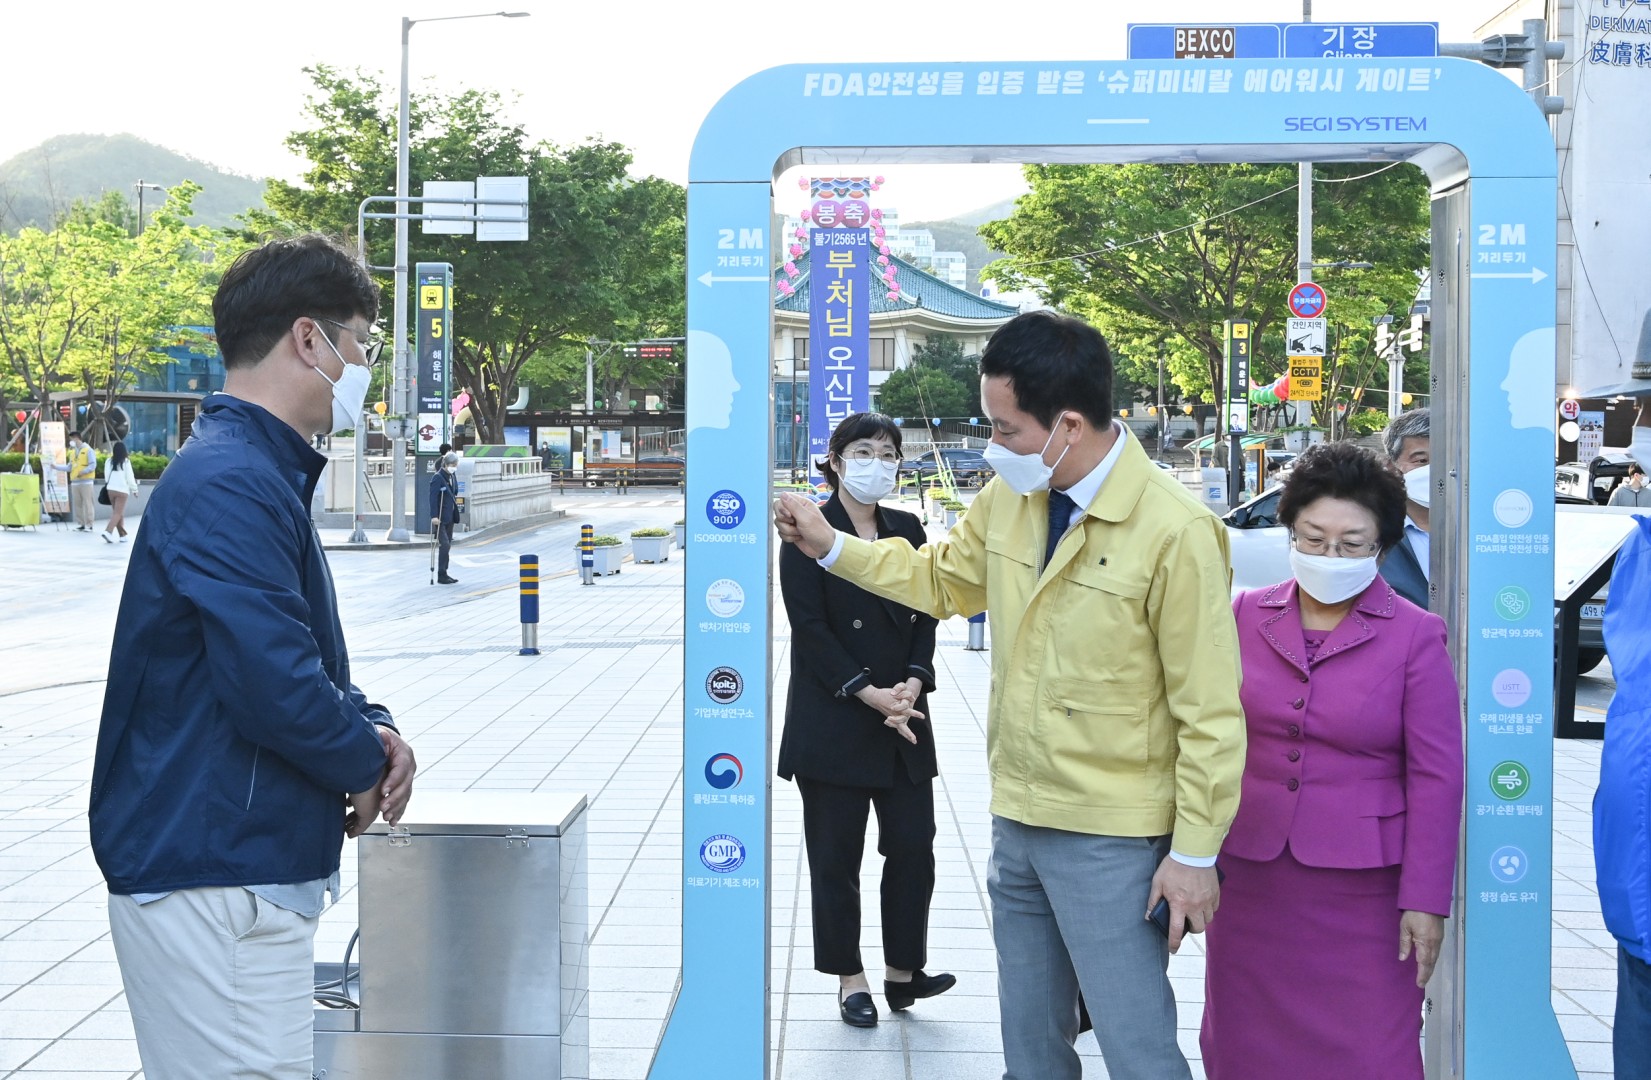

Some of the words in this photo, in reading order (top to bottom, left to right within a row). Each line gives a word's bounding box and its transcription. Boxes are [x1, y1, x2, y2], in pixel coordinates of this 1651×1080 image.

[1176, 29, 1233, 52] BEXCO
[1322, 26, 1377, 50] 기장
[804, 70, 964, 97] FDA안전성을
[976, 71, 1024, 95] 입증
[1036, 70, 1085, 95] 받은
[1243, 68, 1344, 93] 에어워시
[1284, 117, 1333, 131] SEGI
[1336, 117, 1427, 131] SYSTEM
[816, 203, 865, 225] 봉축
[717, 228, 764, 249] 2M
[1478, 223, 1526, 245] 2M
[717, 256, 764, 267] 거리두기
[1477, 252, 1526, 263] 거리두기
[825, 250, 856, 337] 부처님
[431, 318, 442, 339] 5
[1239, 342, 1247, 354] 3
[433, 349, 442, 383] 해운대
[1293, 368, 1317, 376] CCTV
[1564, 402, 1577, 417] 약
[712, 499, 740, 510] ISO
[713, 516, 739, 524] 9001
[739, 533, 757, 544] 인증
[1509, 534, 1532, 544] 안전성
[1533, 534, 1550, 544] 인증
[1475, 545, 1508, 554] FDA피부
[1509, 545, 1532, 554] 안전성
[1533, 545, 1550, 554] 인증
[699, 621, 752, 633] 벤처기업인증
[1481, 628, 1508, 639] 항균력
[1508, 628, 1543, 638] 99.99%
[713, 679, 737, 690] koita
[1502, 683, 1520, 691] USTT
[694, 708, 755, 719] 기업부설연구소
[1479, 713, 1497, 724] 유해
[1498, 713, 1524, 724] 미생물
[1525, 713, 1543, 724] 살균
[1488, 725, 1515, 734] 테스트
[1516, 725, 1534, 735] 완료
[1475, 804, 1495, 816] 공기
[1495, 804, 1515, 816] 순환
[1516, 804, 1543, 816] 필터링
[709, 844, 737, 857] GMP
[687, 877, 721, 888] 의료기기
[722, 877, 741, 888] 제조
[742, 878, 760, 889] 허가
[1480, 891, 1498, 903] 청정
[1500, 891, 1518, 903] 습도
[1519, 891, 1538, 903] 유지
